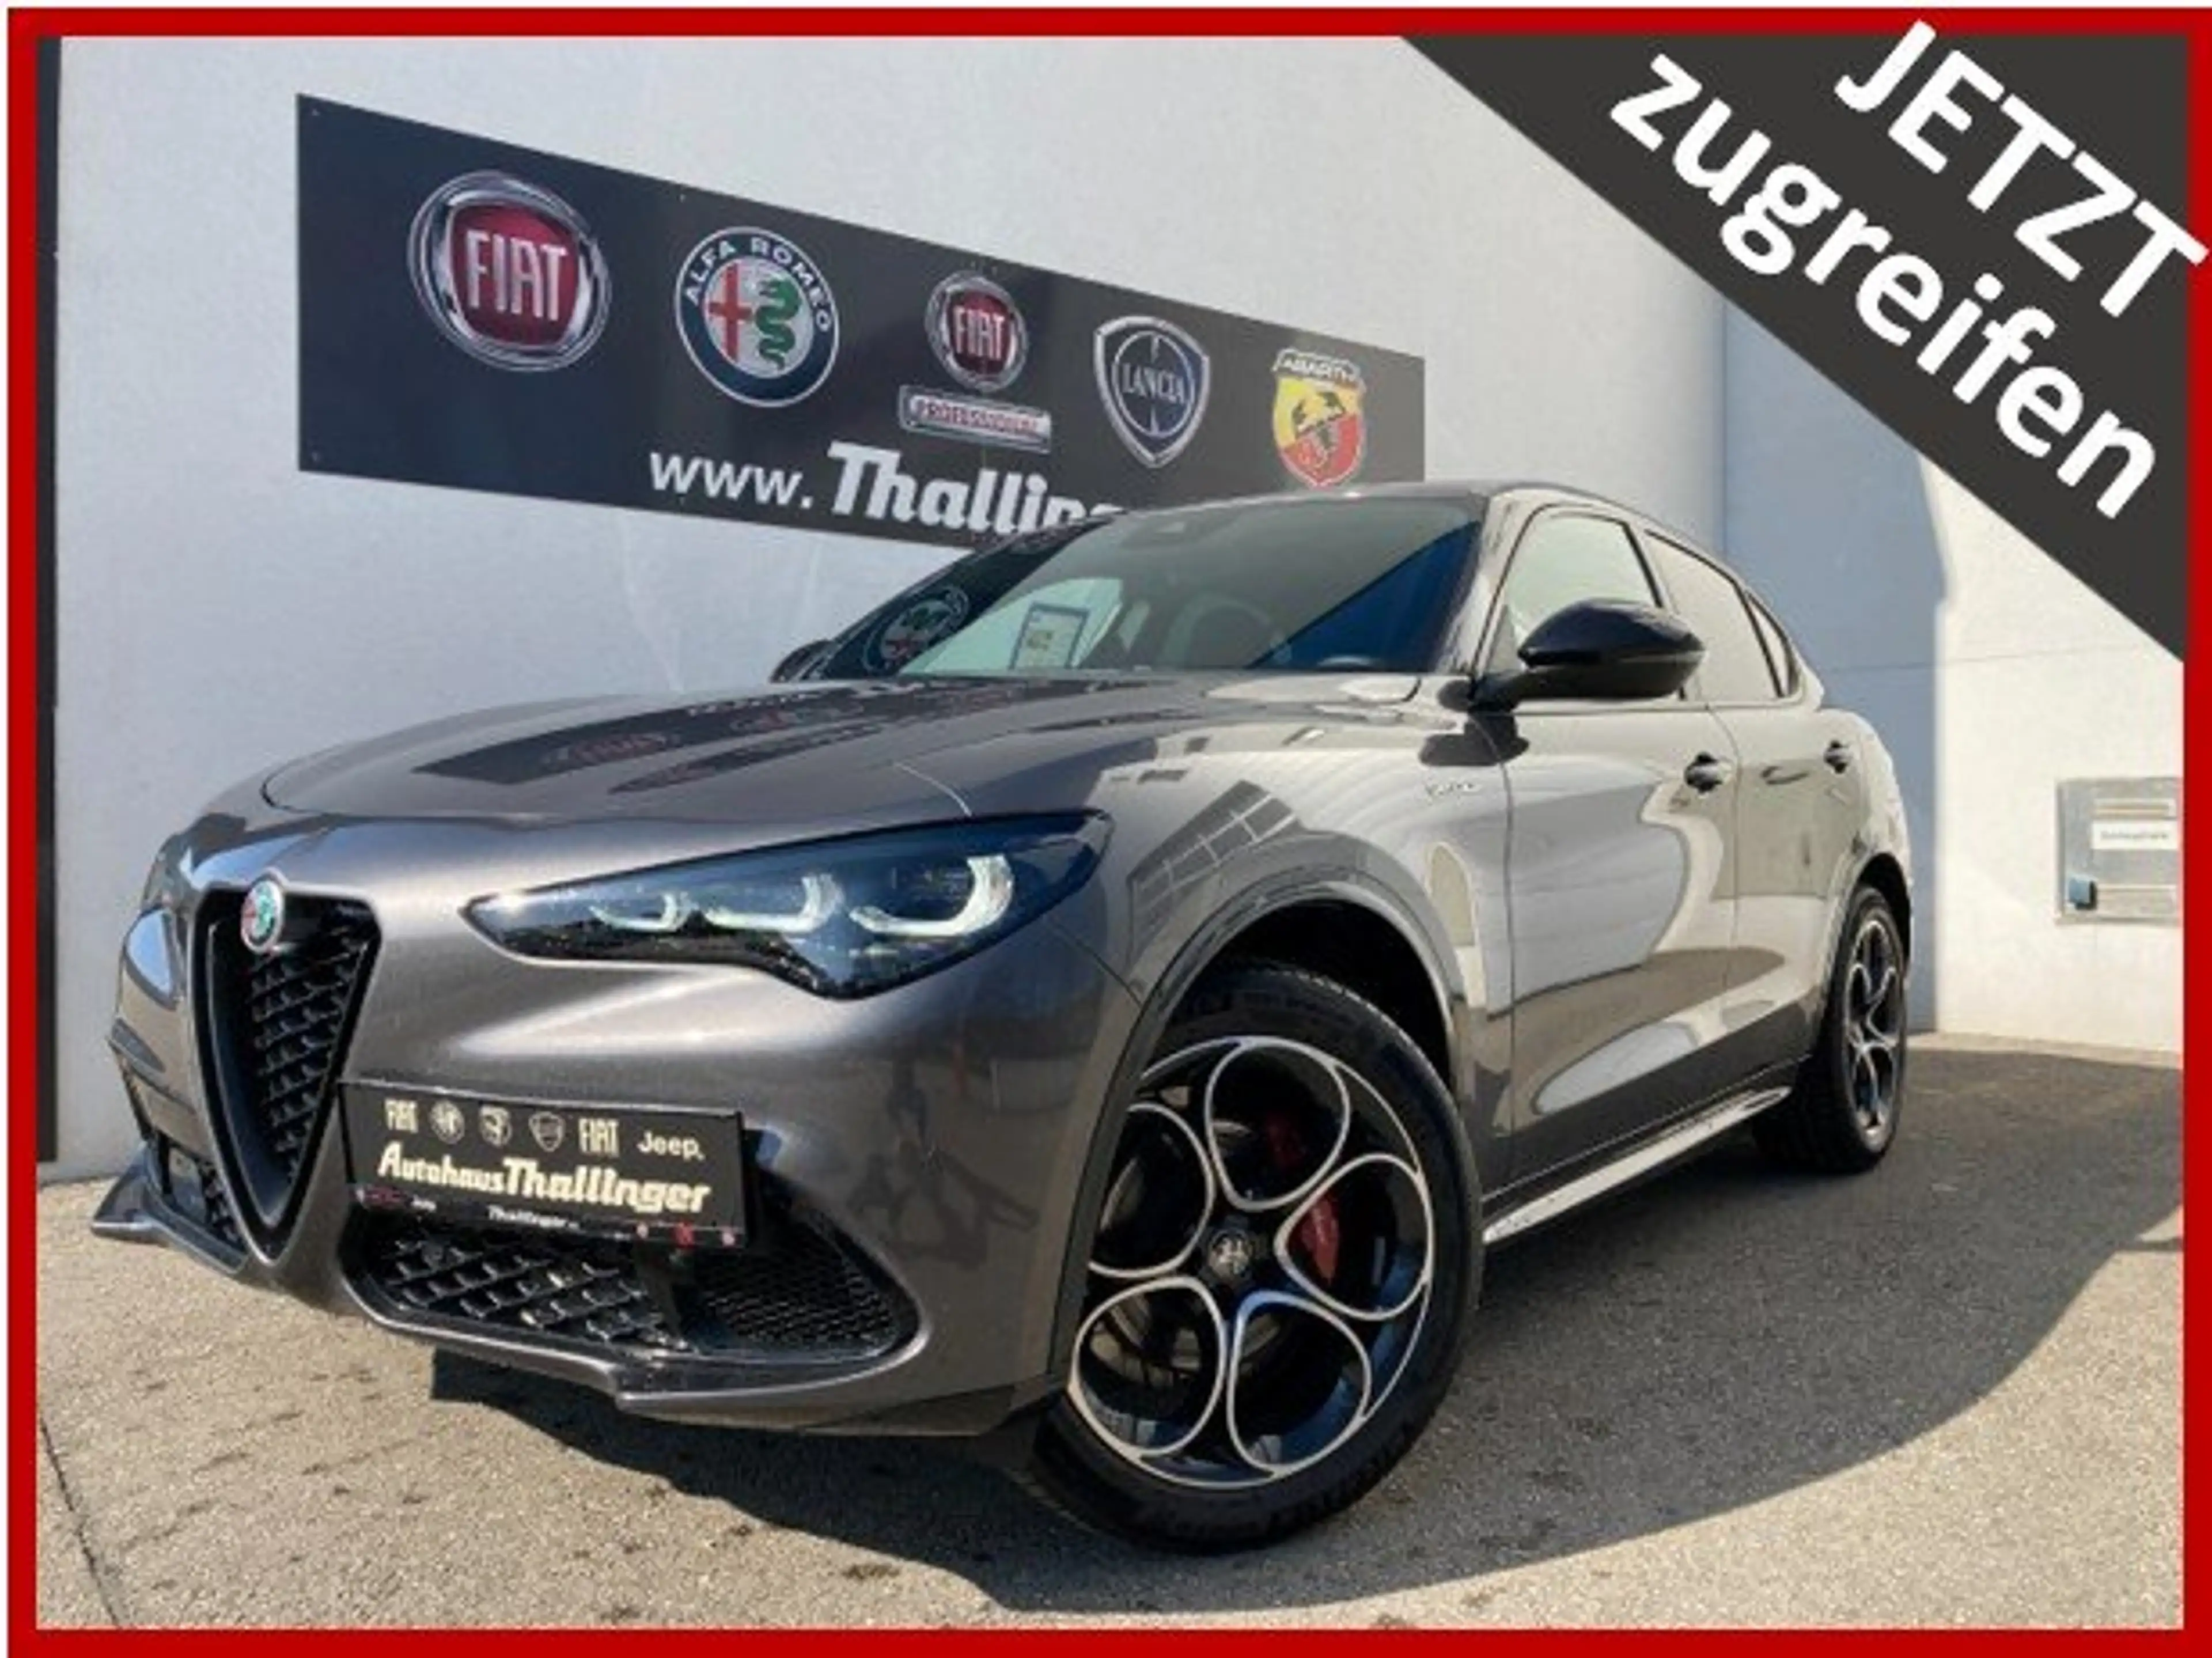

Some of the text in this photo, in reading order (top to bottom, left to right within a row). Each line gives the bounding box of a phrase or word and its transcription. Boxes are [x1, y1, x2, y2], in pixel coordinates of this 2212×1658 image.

[465, 230, 568, 321] FIAT
[685, 237, 831, 332] ALFA ROMEO
[954, 305, 1006, 361] FIAT
[1122, 363, 1184, 405] LANCIA
[578, 1118, 619, 1157] FIAT
